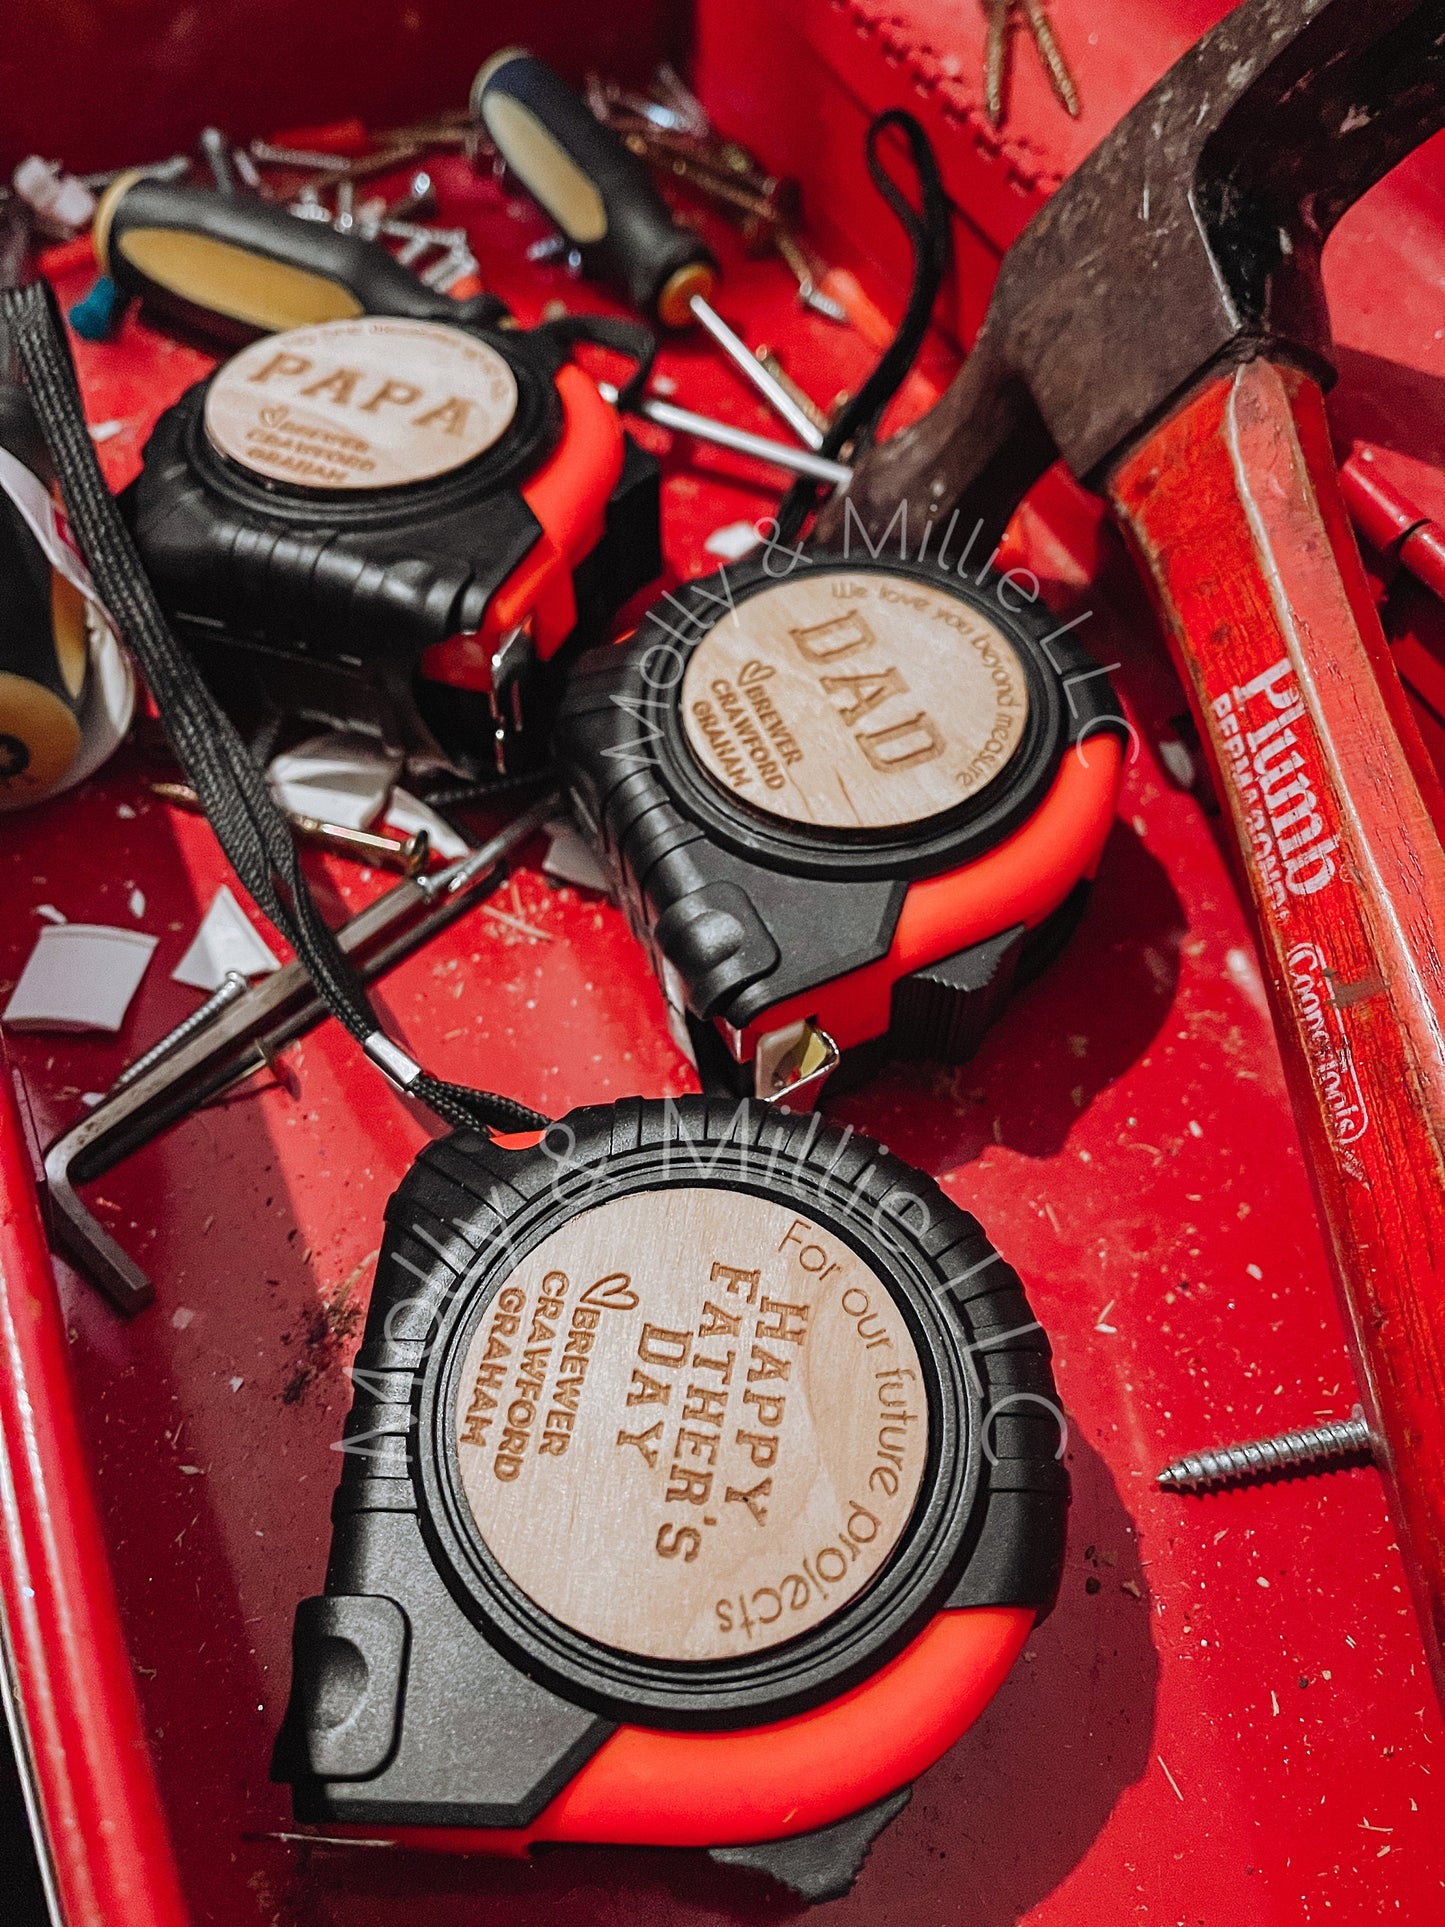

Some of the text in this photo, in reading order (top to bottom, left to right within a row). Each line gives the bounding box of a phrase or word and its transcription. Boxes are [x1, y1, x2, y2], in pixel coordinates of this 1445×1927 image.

[249, 351, 475, 438] PAPA
[691, 700, 754, 789] GRAHAM
[710, 678, 786, 791] CRAWFORD
[747, 683, 804, 766] BREWER
[789, 608, 947, 774] DAD
[831, 581, 1022, 788] We love you beyond measure
[1232, 657, 1342, 896] Plumb
[459, 1287, 527, 1447] GRAHAM
[493, 1270, 570, 1483] CRAWFORD
[538, 1306, 600, 1457] BREWER
[616, 1322, 695, 1469] DAY
[655, 1262, 762, 1563] FATHER'S
[715, 1218, 919, 1640] For our future projects
[724, 1295, 811, 1527] HAPPY
